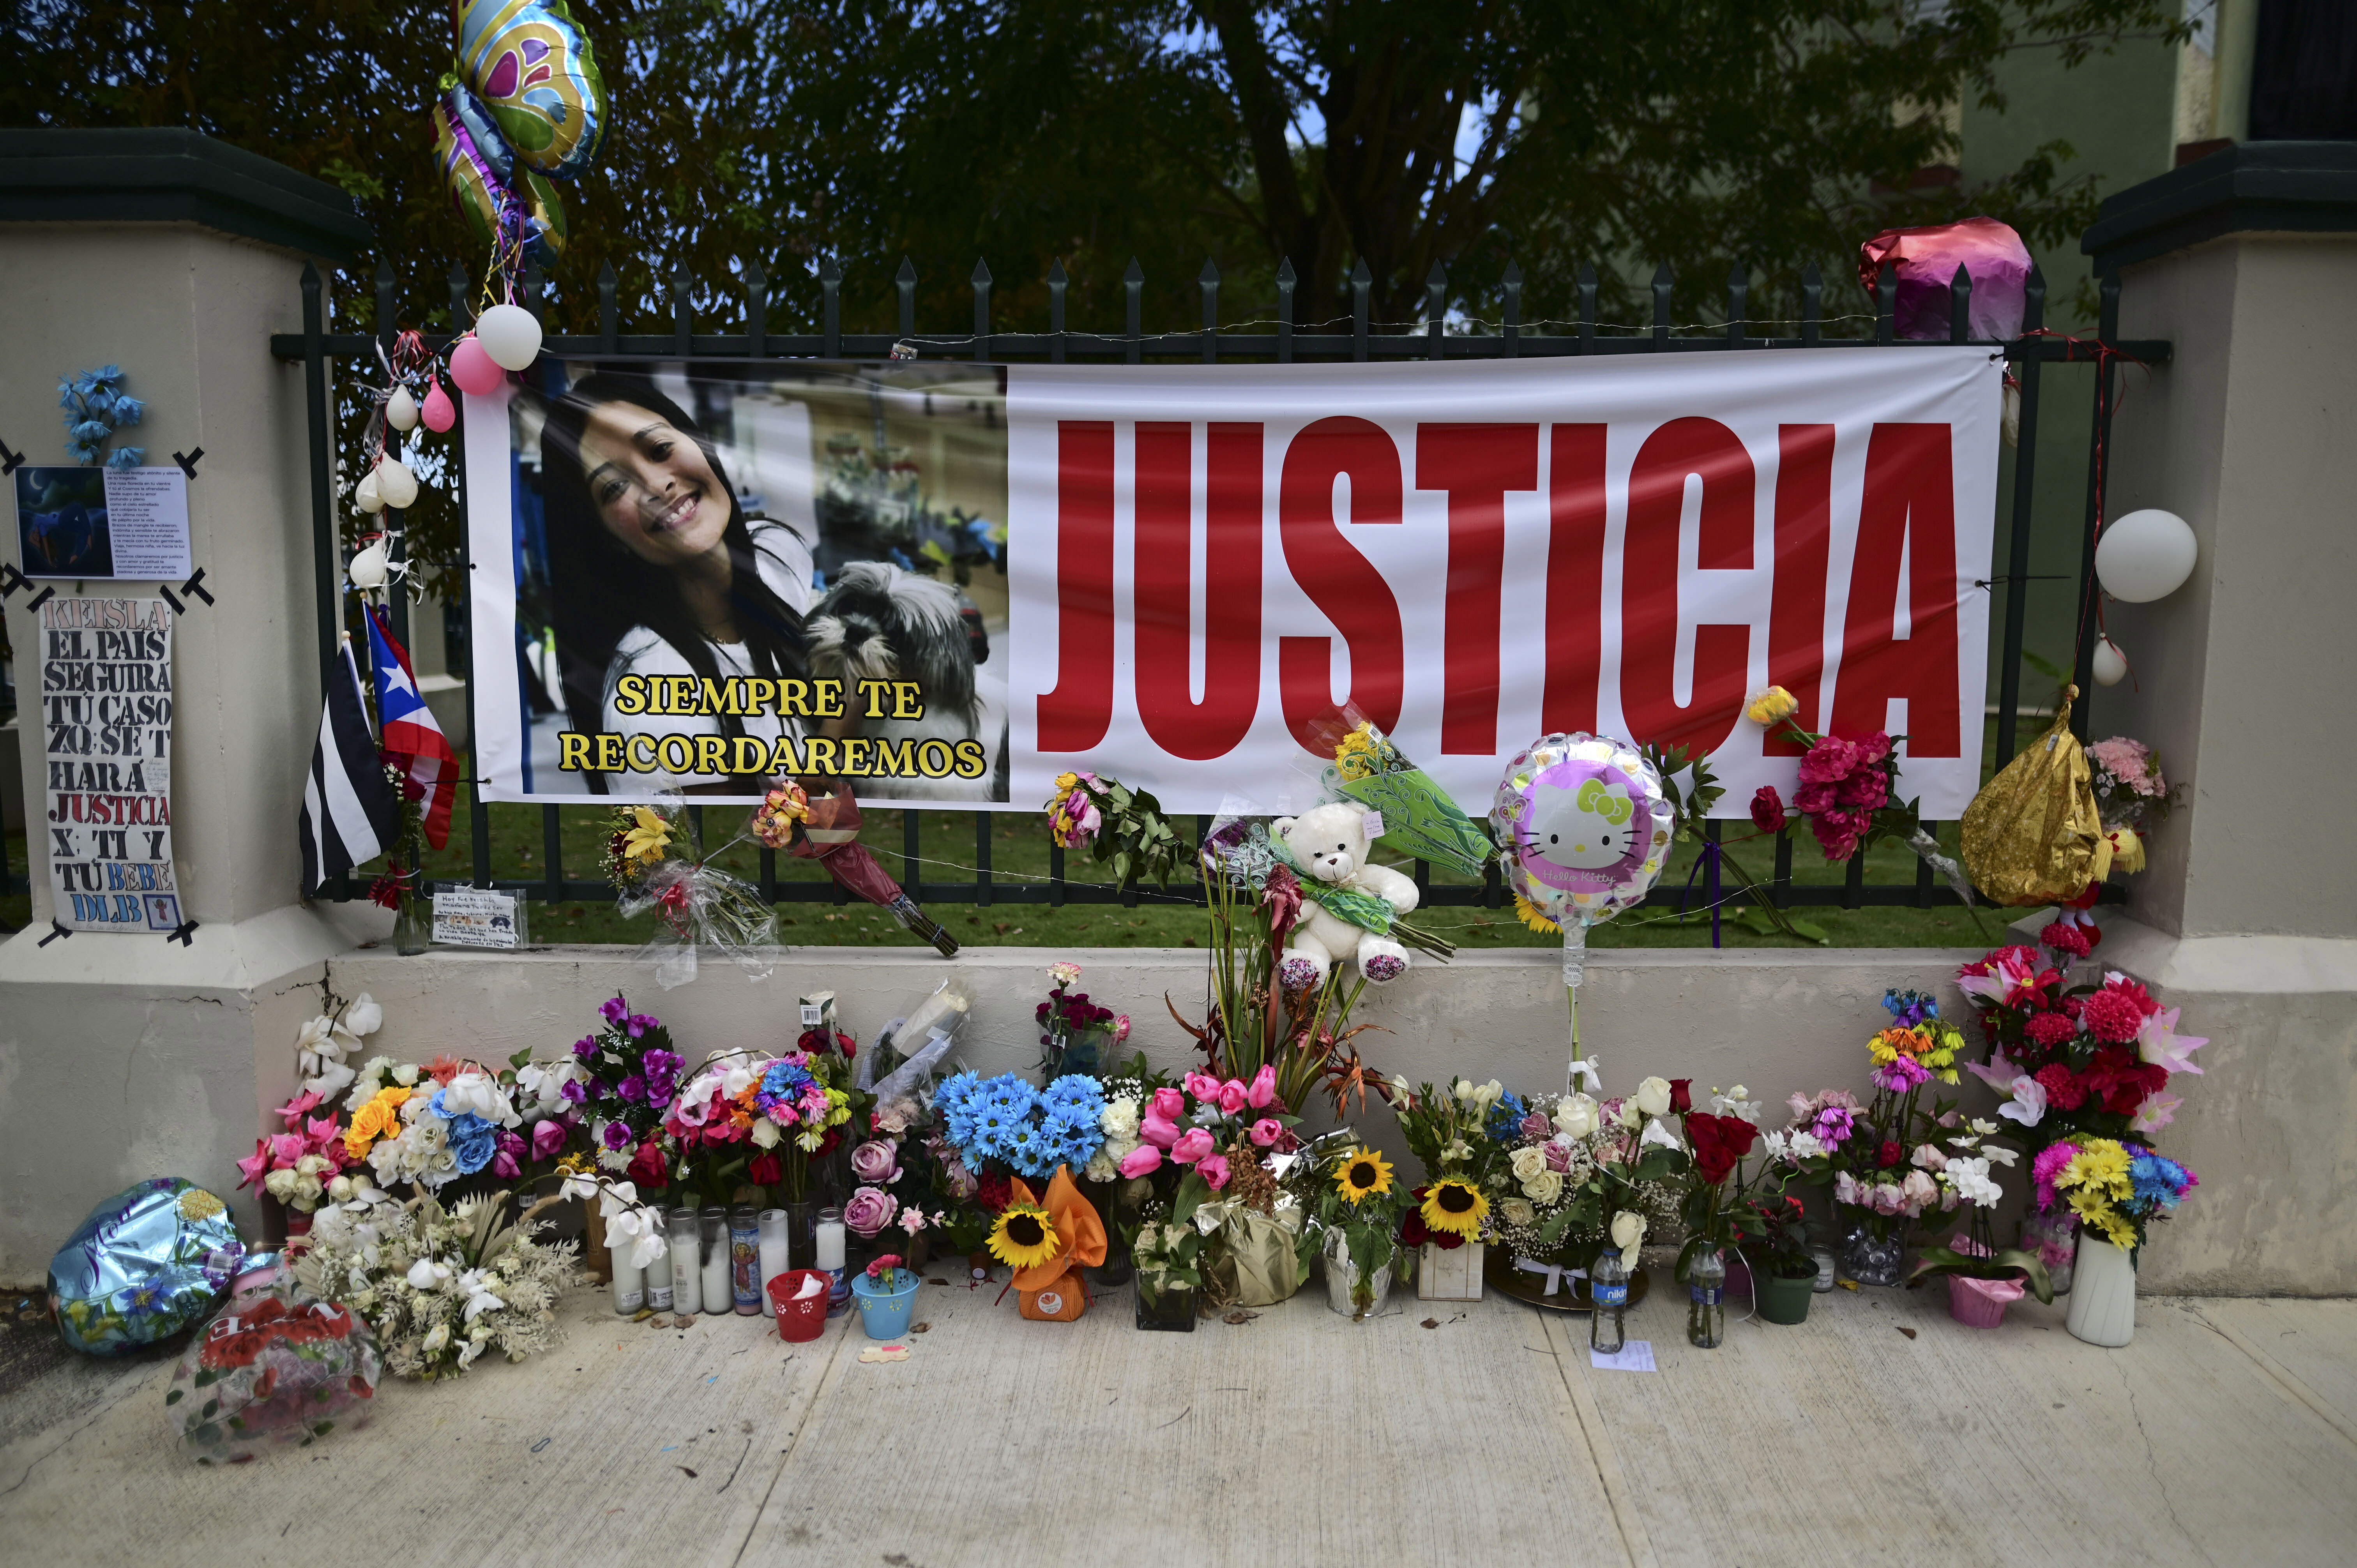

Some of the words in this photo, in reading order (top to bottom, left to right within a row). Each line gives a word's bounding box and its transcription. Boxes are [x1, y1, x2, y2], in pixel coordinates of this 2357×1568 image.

[1037, 415, 1960, 761] JUSTICIA
[48, 630, 90, 659] EL
[96, 629, 165, 660] PAÍS
[44, 661, 171, 692] SEGUIRÁ
[43, 692, 94, 725] TÚ
[99, 695, 171, 726] CASO
[616, 673, 846, 719] SIEMPRE
[857, 679, 926, 720] TE
[149, 730, 170, 758] T
[558, 731, 986, 777] RECORDAREMOS
[49, 759, 147, 792] HARÁ
[48, 793, 170, 826] JUSTICIA
[92, 825, 129, 860] TÍ
[143, 831, 164, 860] Y
[55, 858, 102, 891] TÚ
[106, 860, 173, 890] BEBÉ
[1542, 869, 1578, 881] Hello
[1581, 871, 1616, 887] Kitty
[70, 894, 142, 922] DLB
